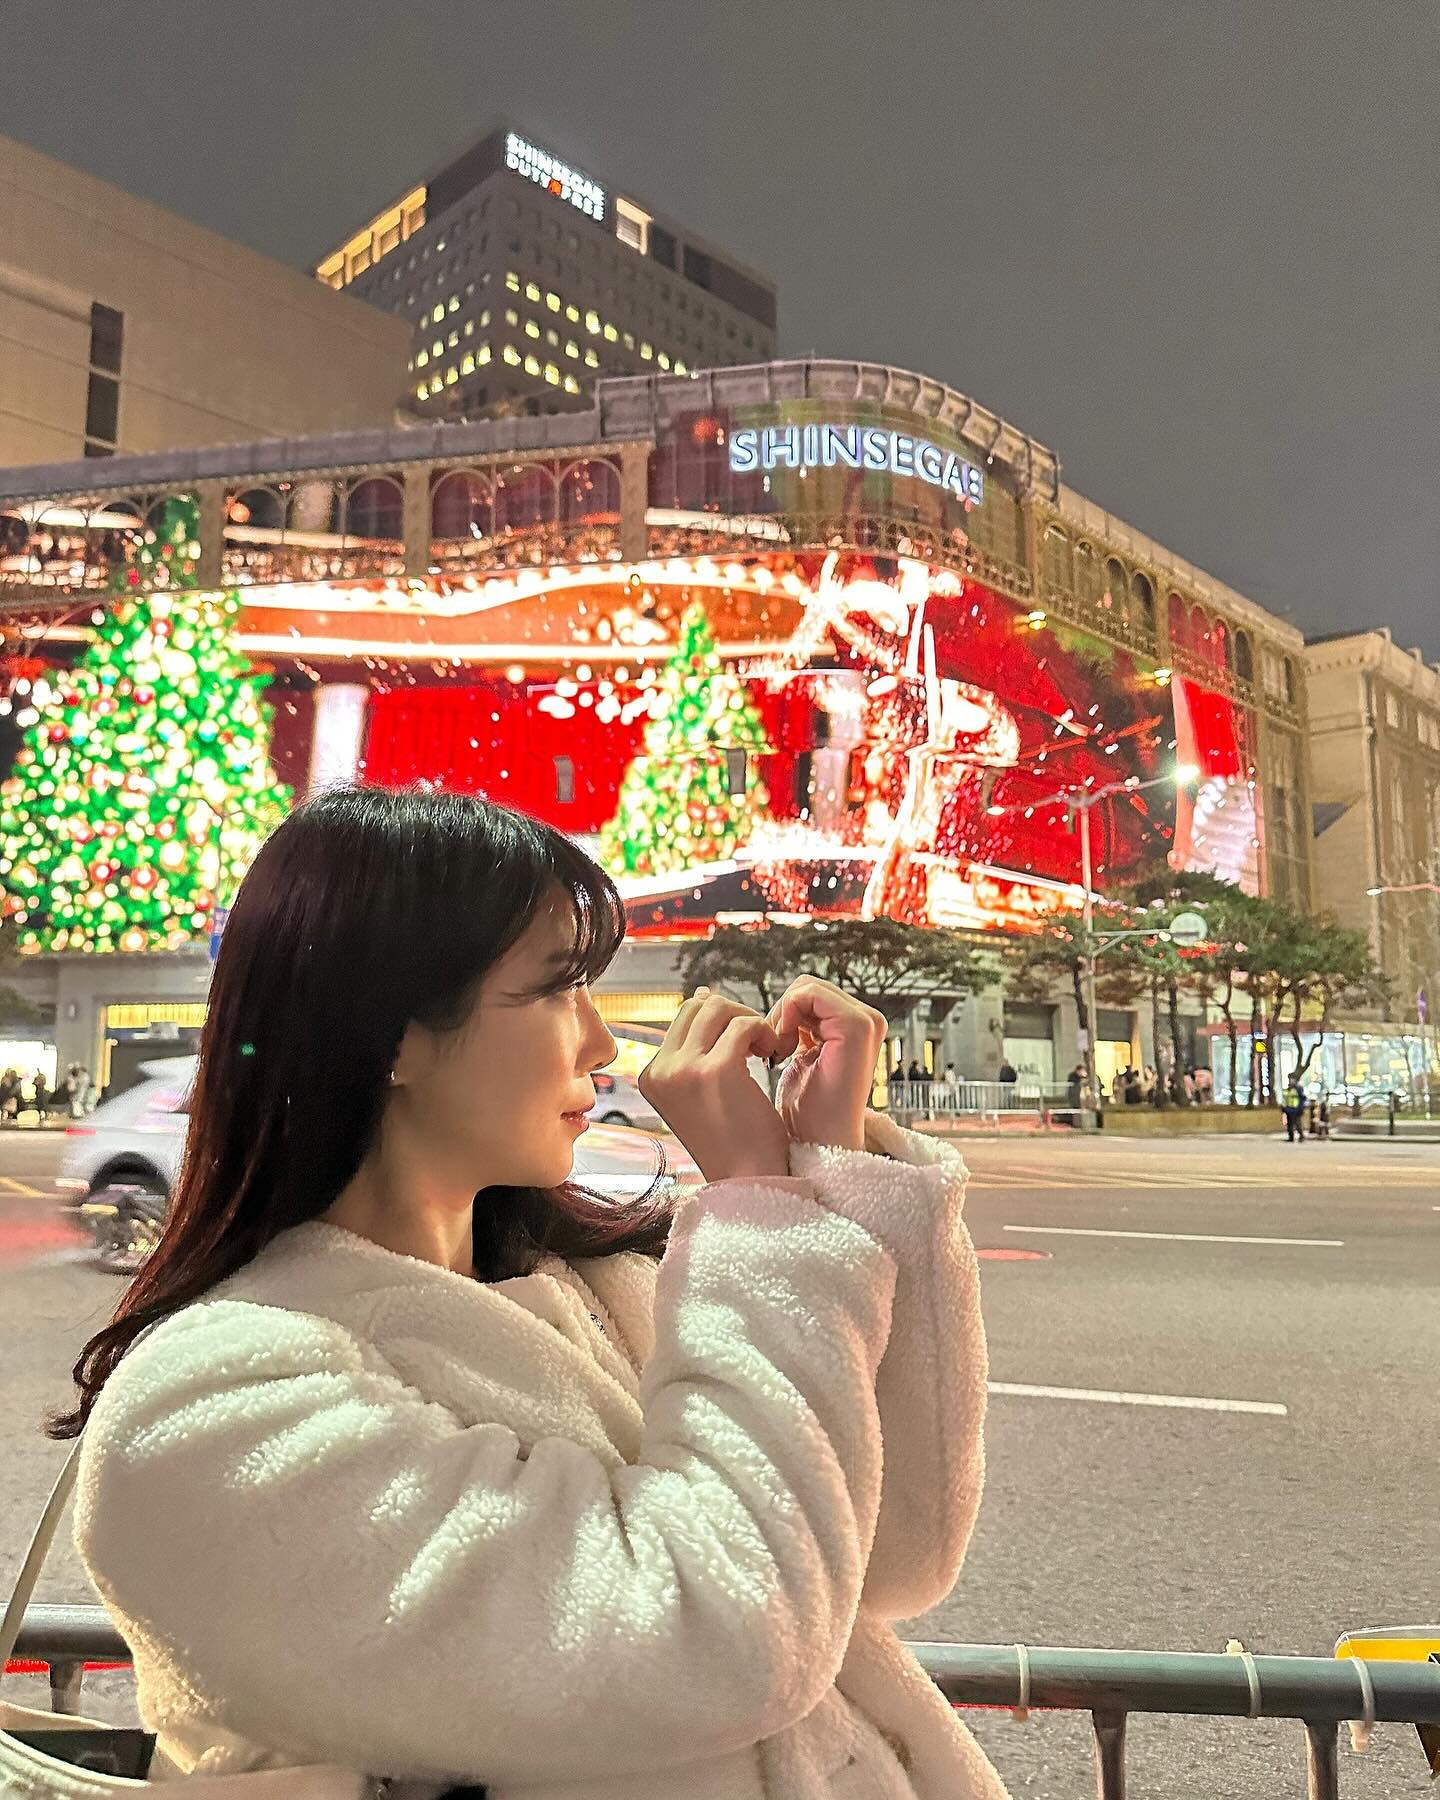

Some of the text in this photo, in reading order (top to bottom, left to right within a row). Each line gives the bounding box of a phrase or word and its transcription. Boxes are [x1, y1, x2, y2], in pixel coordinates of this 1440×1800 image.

[506, 133, 605, 206] SHINSEGAE
[506, 152, 604, 221] DUTY FREE
[730, 424, 983, 505] SHINSEGAE
